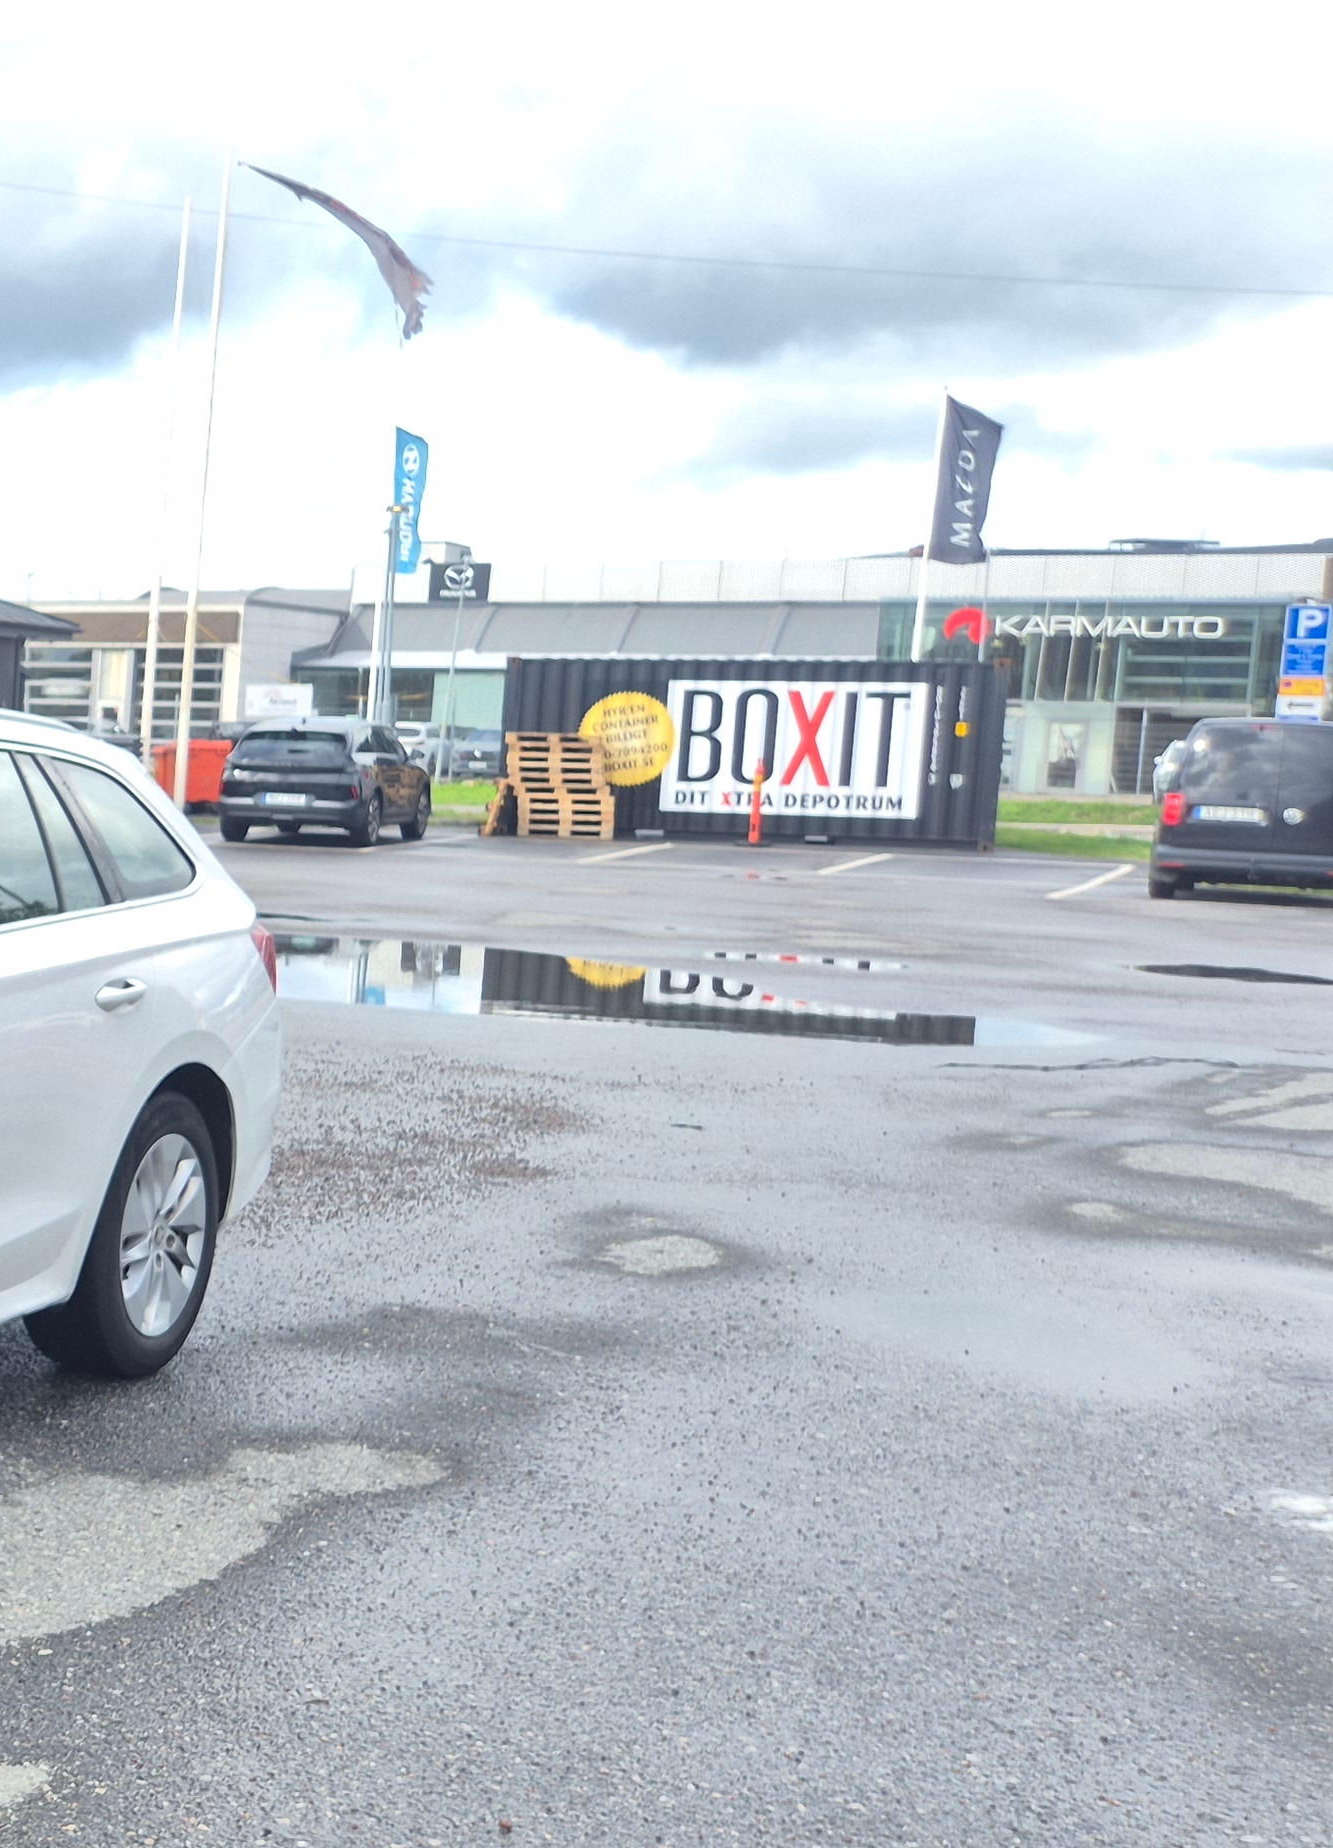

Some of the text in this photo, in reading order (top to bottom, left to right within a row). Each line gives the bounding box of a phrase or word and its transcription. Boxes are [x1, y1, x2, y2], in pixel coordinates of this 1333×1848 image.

[950, 429, 981, 548] MAZDA
[994, 614, 1224, 639] KARMAUTO
[1296, 608, 1323, 638] P
[592, 715, 659, 734] CONTAINER
[676, 689, 911, 787] BOXIT
[674, 790, 708, 805] DIT
[784, 793, 903, 811] DEPOTRUM
